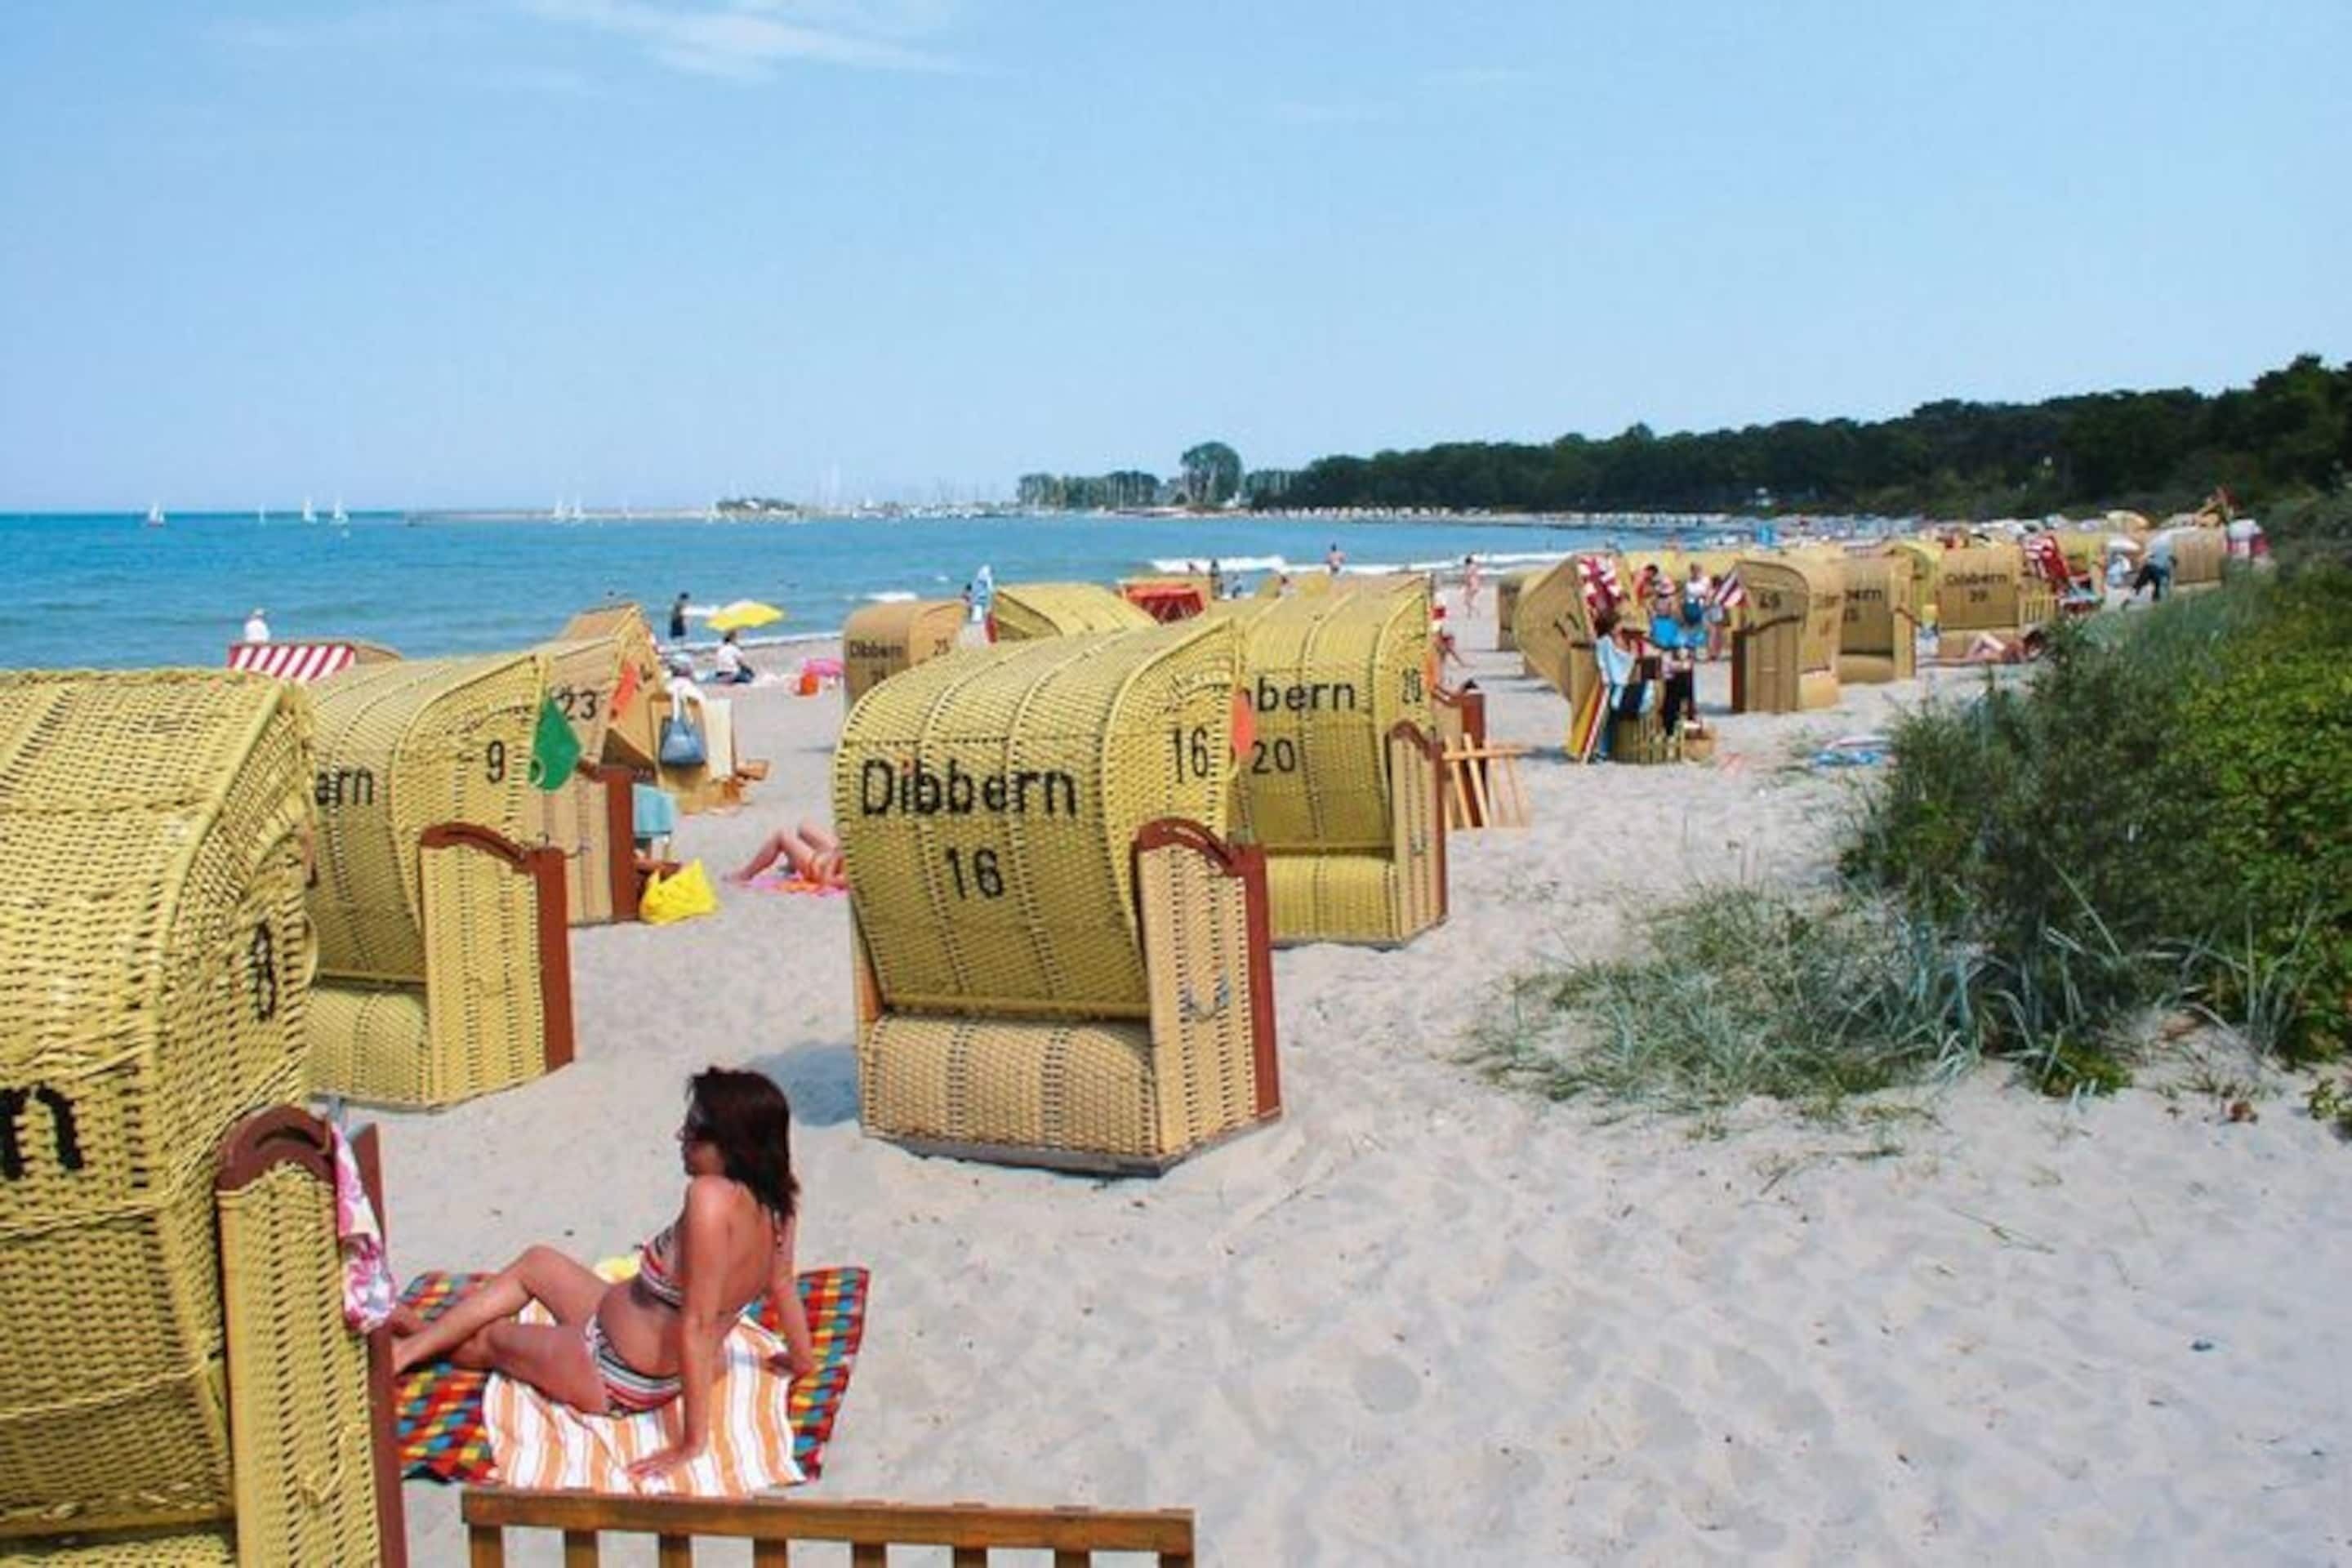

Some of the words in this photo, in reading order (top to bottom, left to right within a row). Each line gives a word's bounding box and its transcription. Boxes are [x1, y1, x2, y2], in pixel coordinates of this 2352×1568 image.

[486, 739, 506, 784] 9
[1174, 725, 1209, 784] 16
[1251, 737, 1296, 774] 20
[862, 758, 1076, 817] Dibbern
